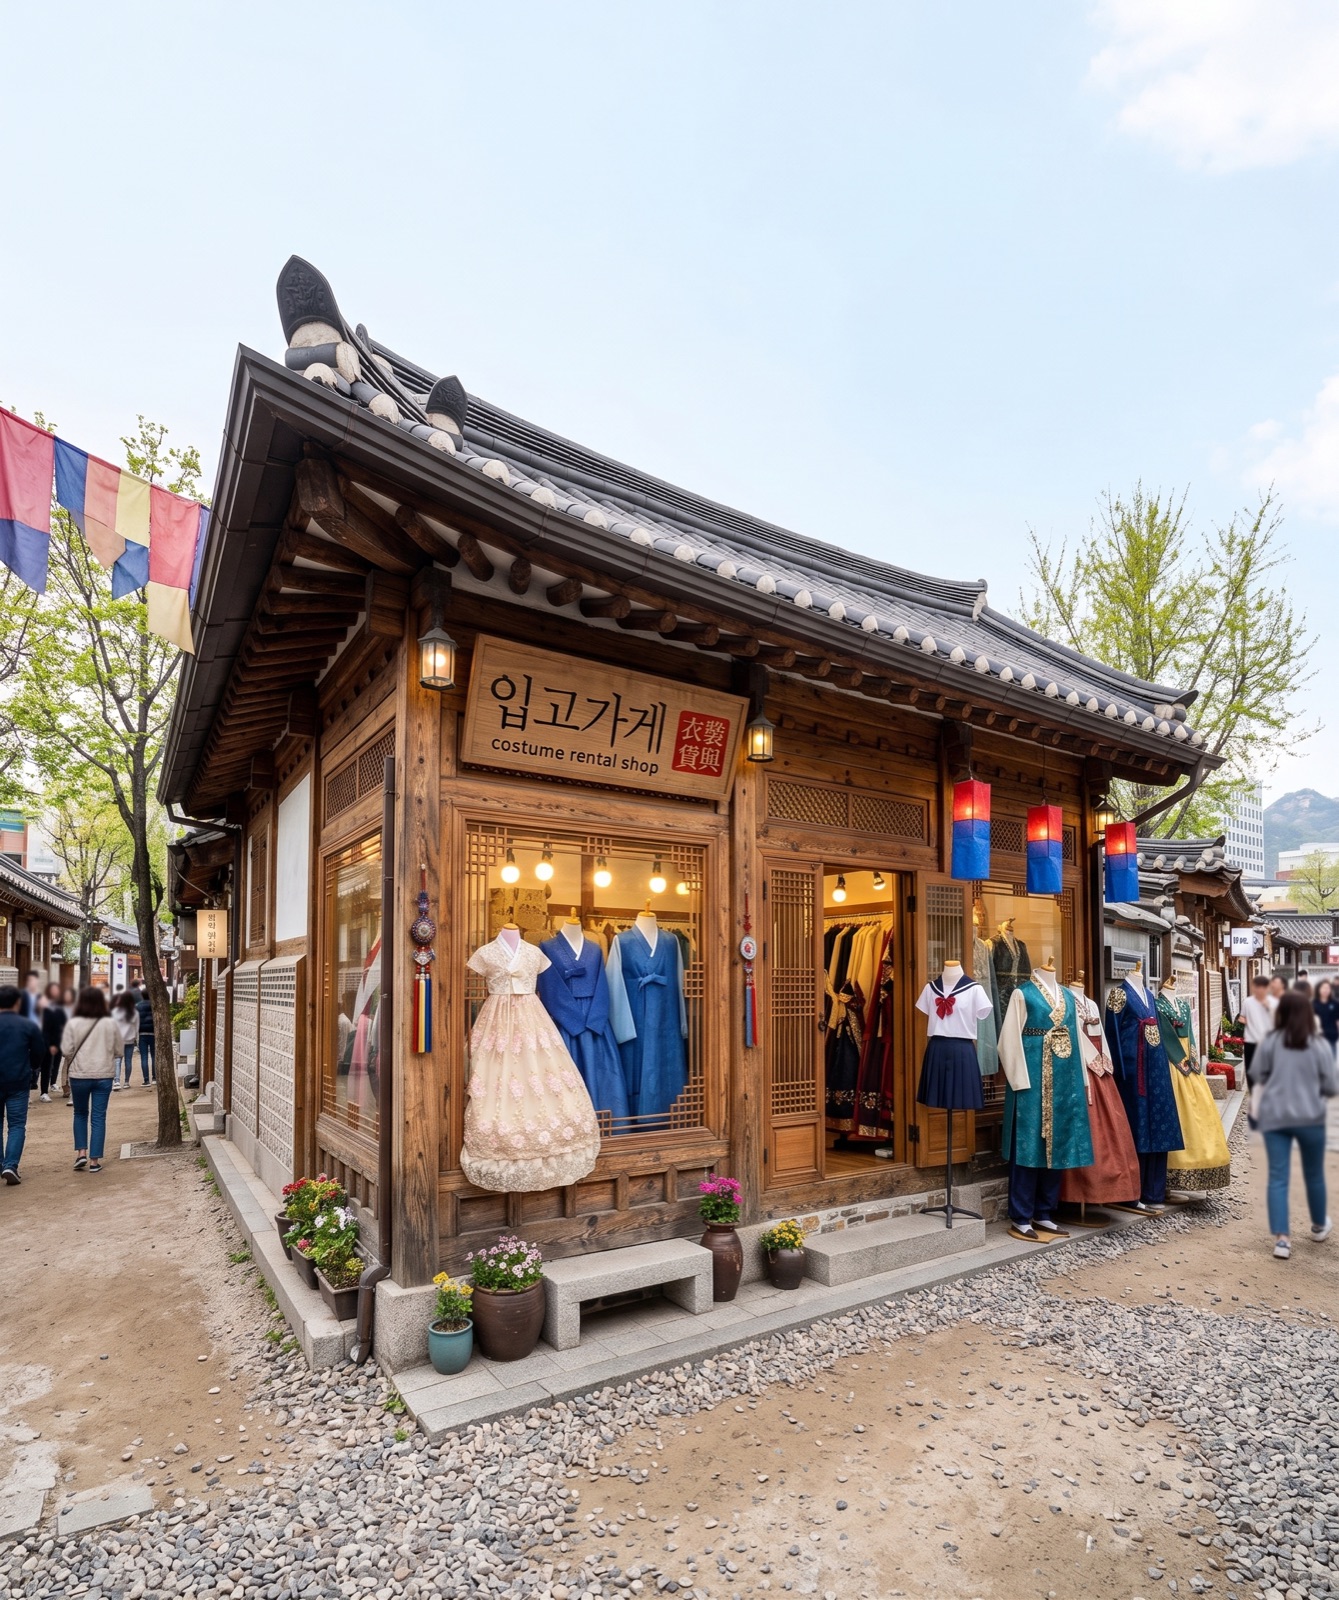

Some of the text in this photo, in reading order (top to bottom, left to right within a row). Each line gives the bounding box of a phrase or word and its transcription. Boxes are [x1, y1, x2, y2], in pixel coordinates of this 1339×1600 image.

[490, 674, 667, 755] 입고가게
[491, 738, 659, 776] costume rental shop
